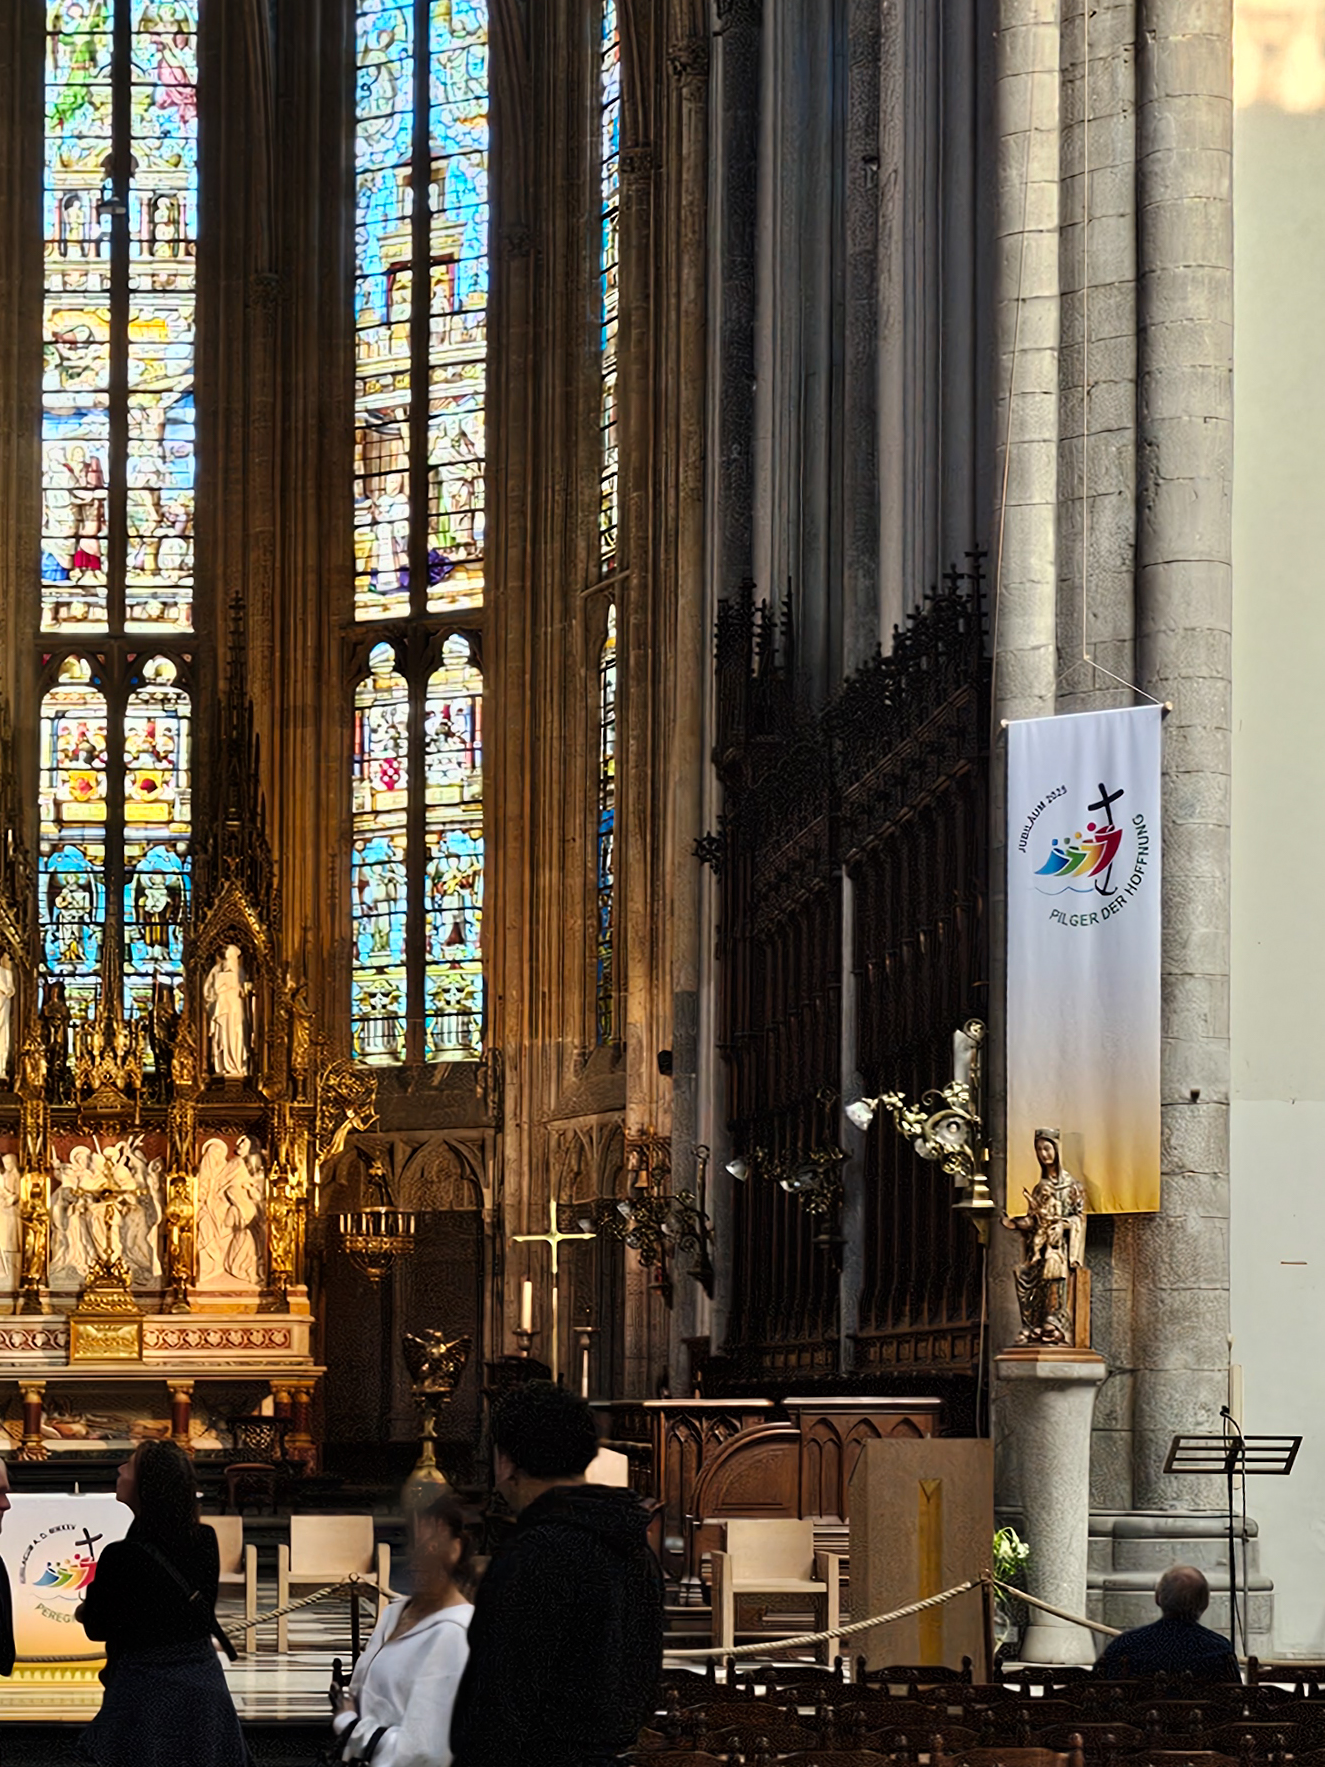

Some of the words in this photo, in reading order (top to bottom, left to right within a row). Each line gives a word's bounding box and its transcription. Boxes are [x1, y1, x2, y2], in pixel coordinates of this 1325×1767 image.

[1049, 908, 1100, 927] PILGER
[1100, 894, 1128, 921] DER
[1123, 813, 1150, 897] HOFFNUNG
